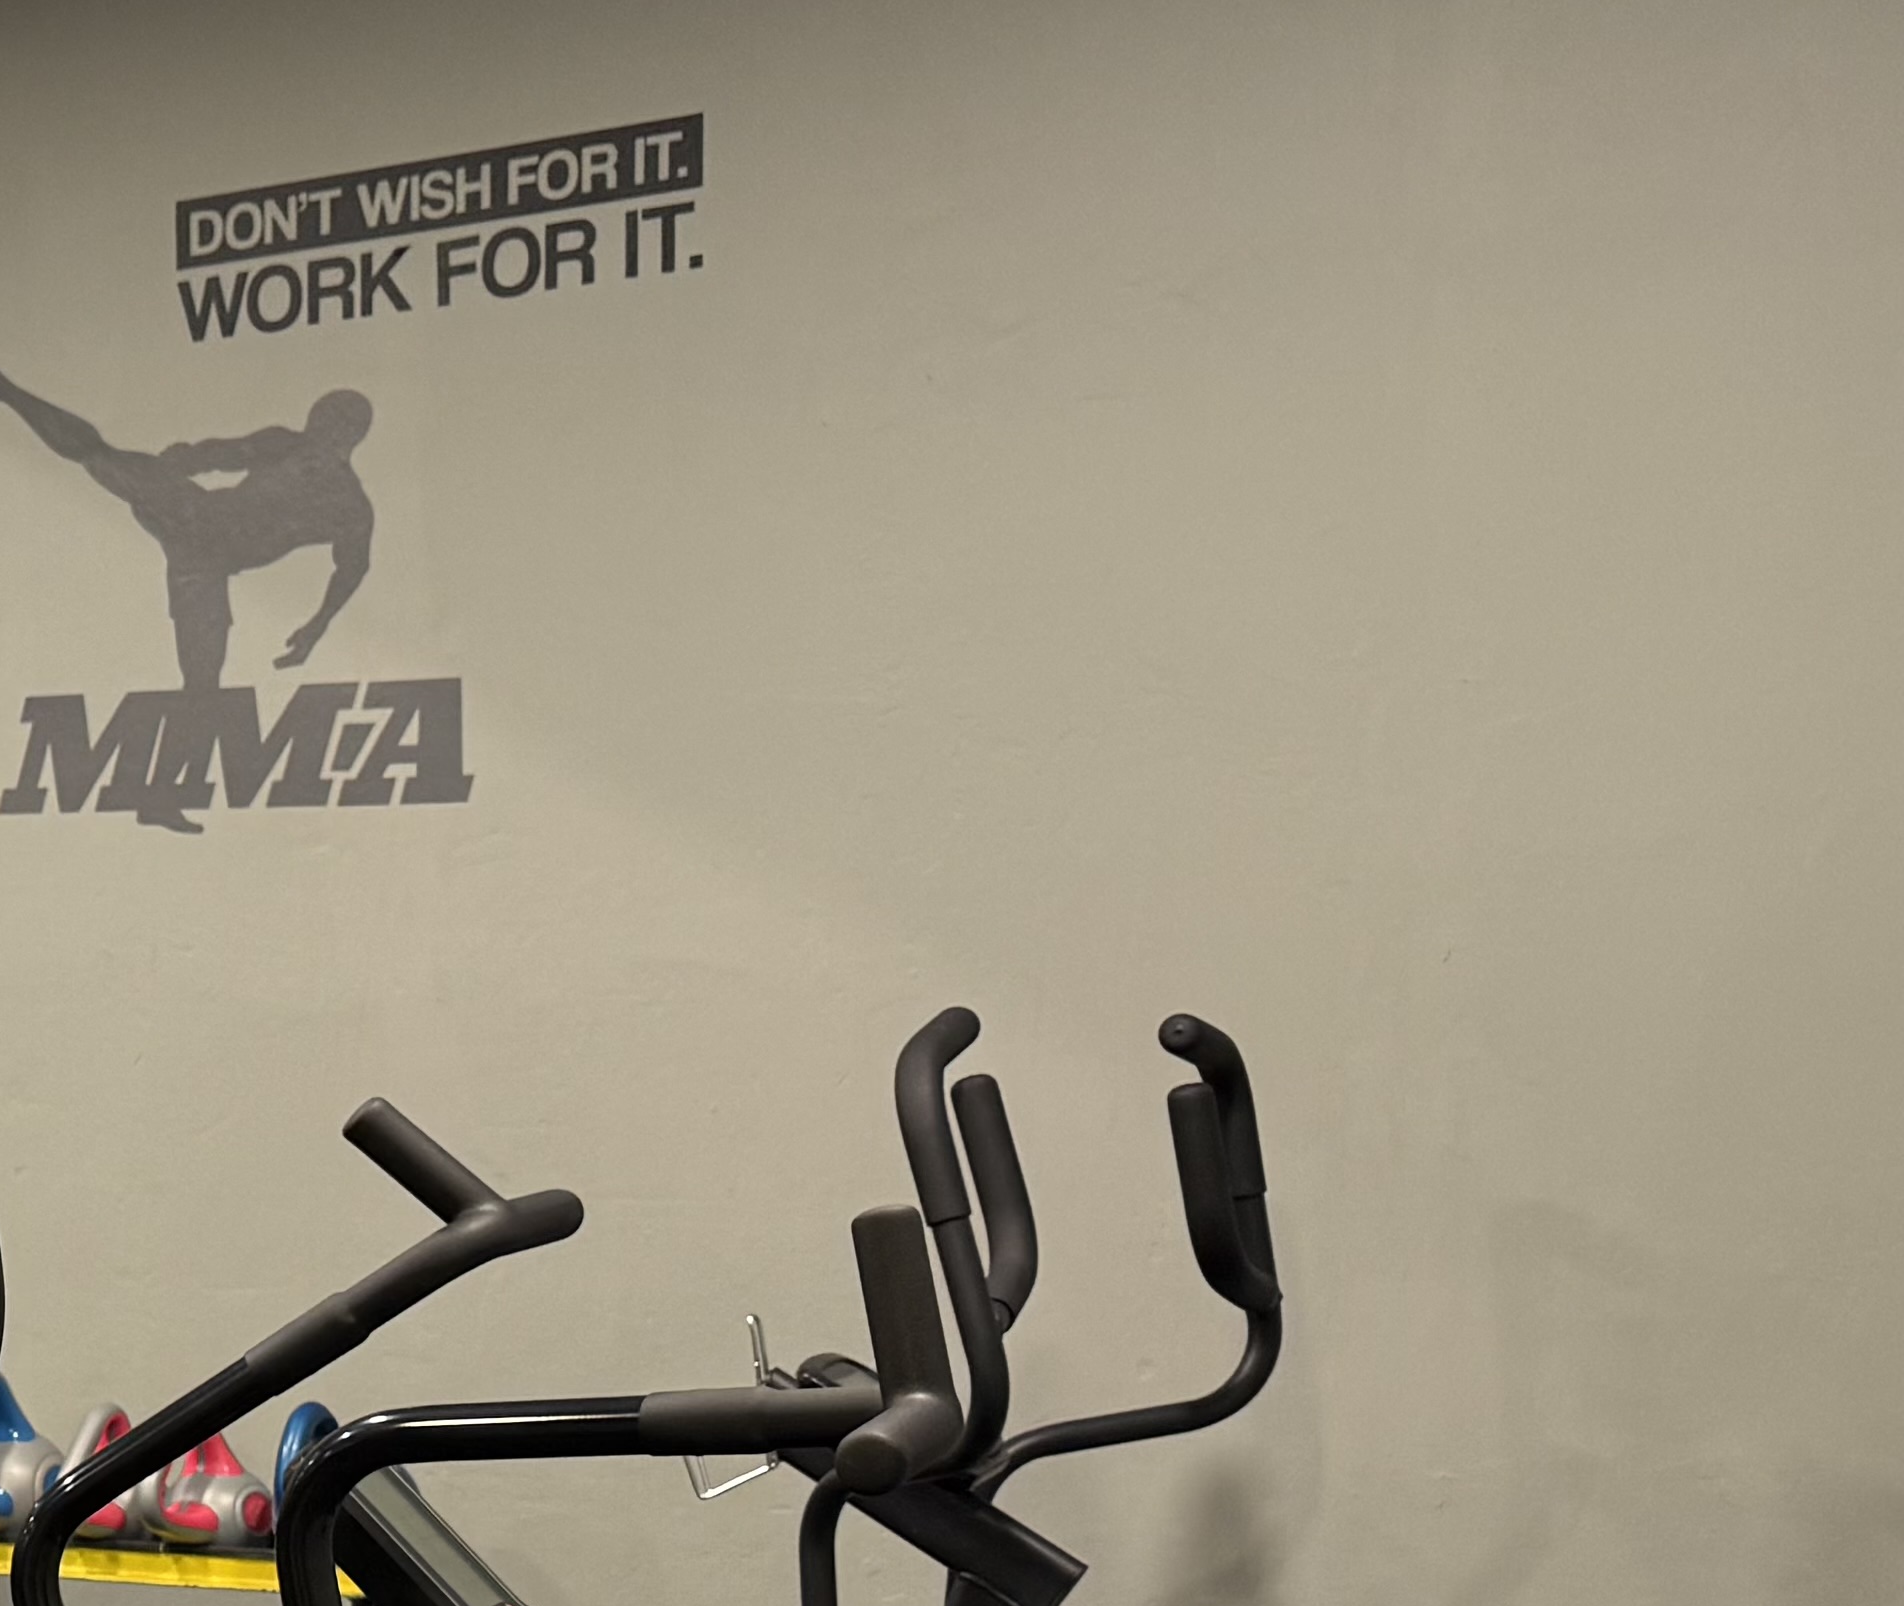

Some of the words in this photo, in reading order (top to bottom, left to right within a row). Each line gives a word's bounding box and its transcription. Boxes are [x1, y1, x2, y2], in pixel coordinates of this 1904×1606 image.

[190, 188, 342, 258] DON'T
[357, 161, 492, 230] WISH
[506, 141, 619, 206] FOR
[632, 129, 690, 186] IT.
[177, 244, 413, 343] WORK
[435, 217, 597, 308] FOR
[623, 200, 704, 279] IT.
